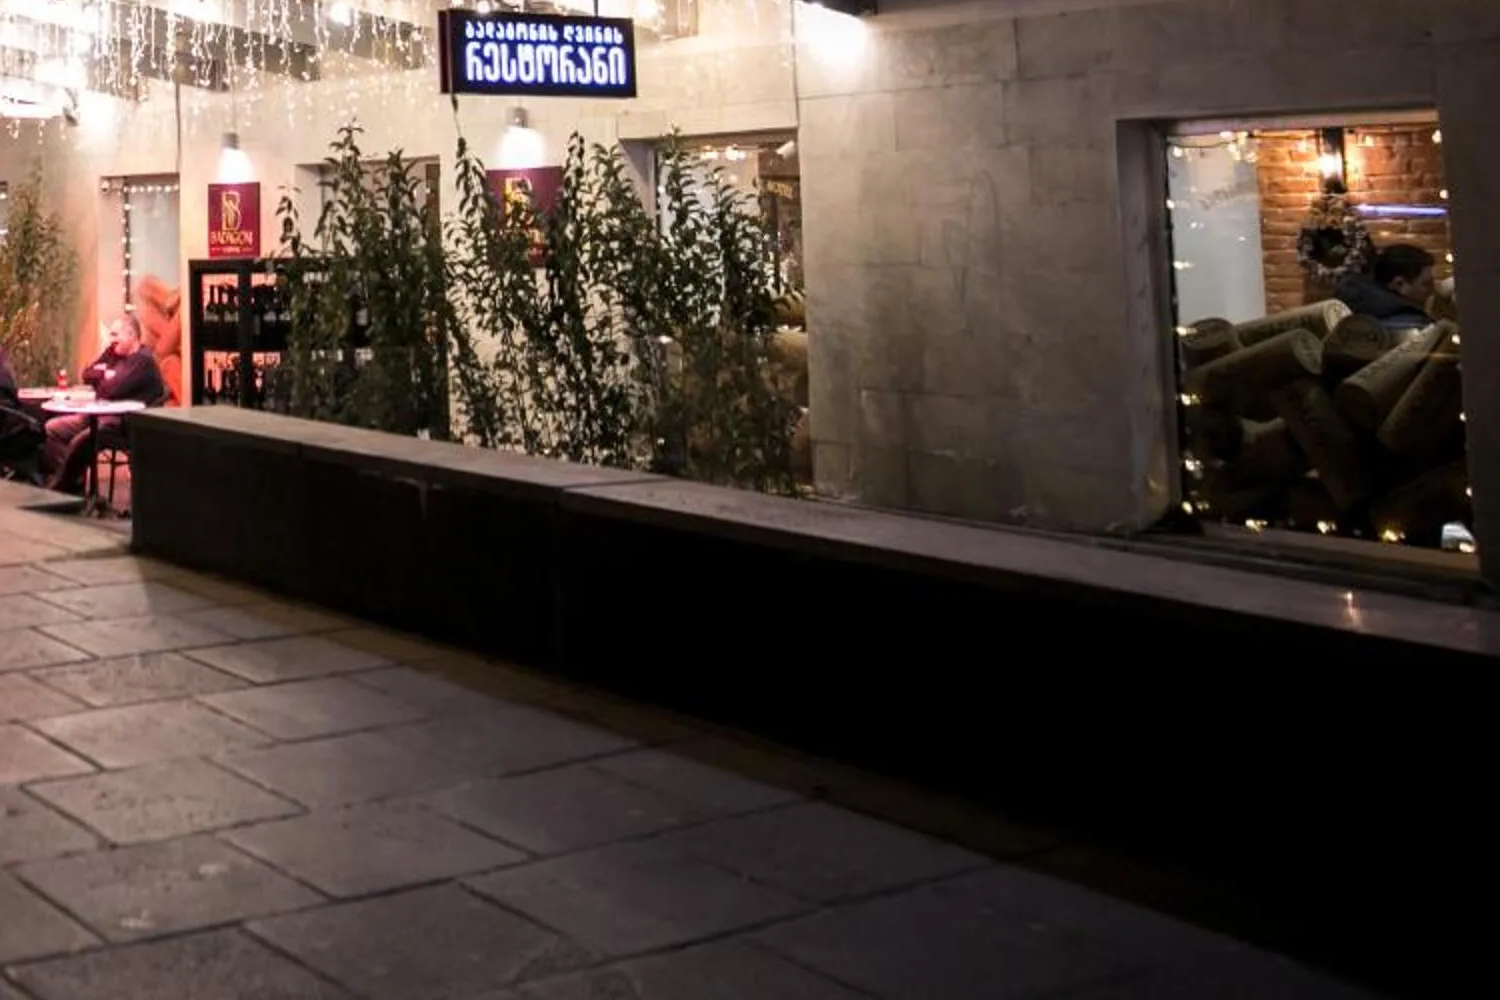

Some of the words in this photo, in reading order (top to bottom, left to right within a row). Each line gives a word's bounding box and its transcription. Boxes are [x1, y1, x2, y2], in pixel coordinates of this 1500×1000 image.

[465, 21, 558, 42] ბადაგონის
[563, 24, 624, 44] ღვინის
[465, 41, 627, 85] რესტორანი
